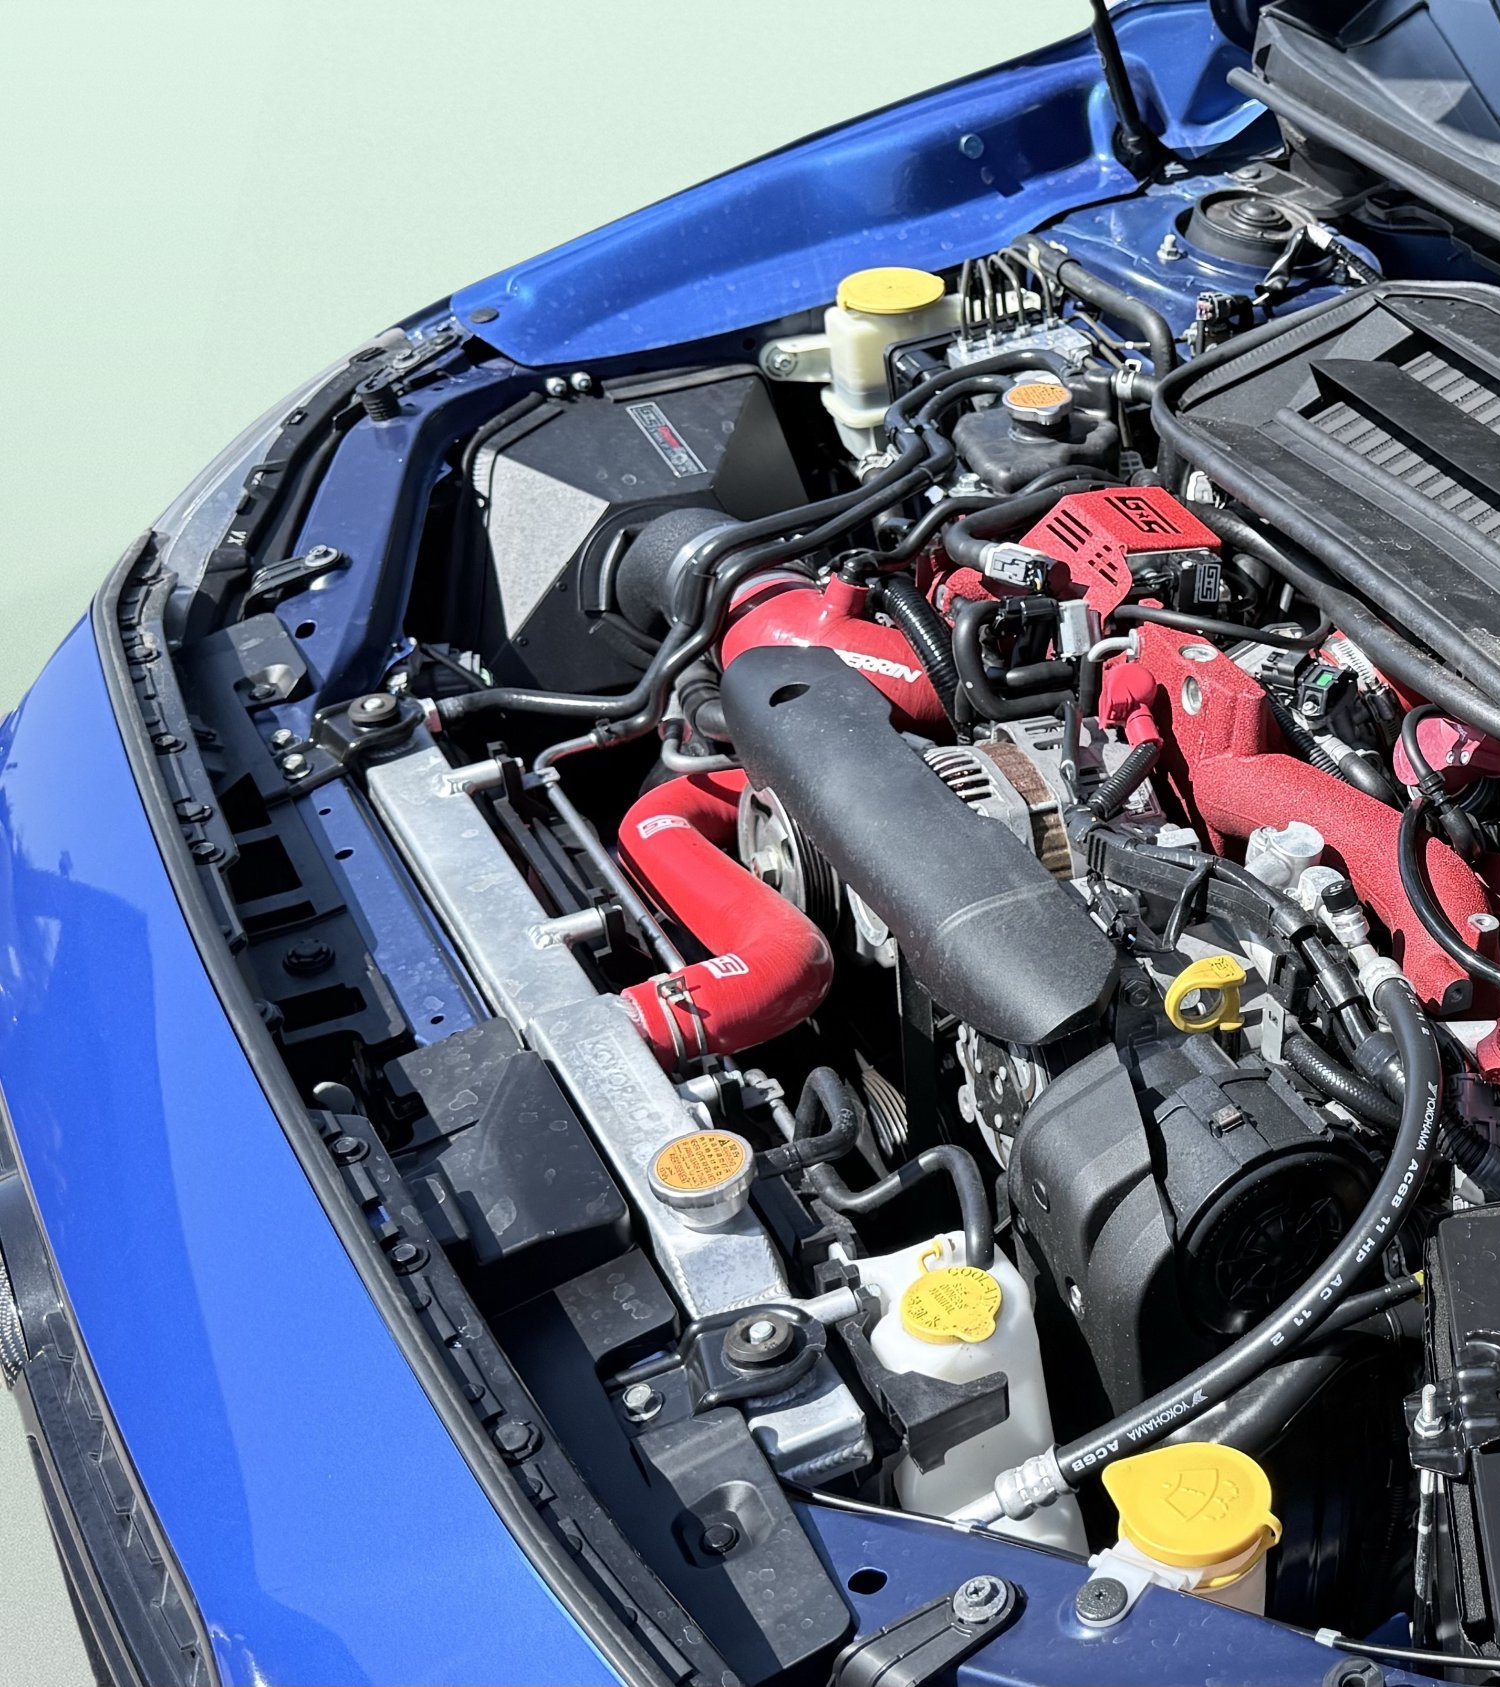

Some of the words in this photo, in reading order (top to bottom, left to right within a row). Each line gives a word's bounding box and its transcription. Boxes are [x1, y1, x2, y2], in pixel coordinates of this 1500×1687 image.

[1416, 1095, 1438, 1151] YOKOHAMA
[1391, 1158, 1419, 1208] AC6B
[1376, 1216, 1391, 1234] 11
[1356, 1237, 1375, 1263] HP
[1319, 1273, 1344, 1300] AC
[1293, 1309, 1312, 1327] 11
[1270, 1331, 1285, 1347] 2
[1126, 1400, 1190, 1441] YOKOHAMA
[1072, 1439, 1120, 1472] AC6B
